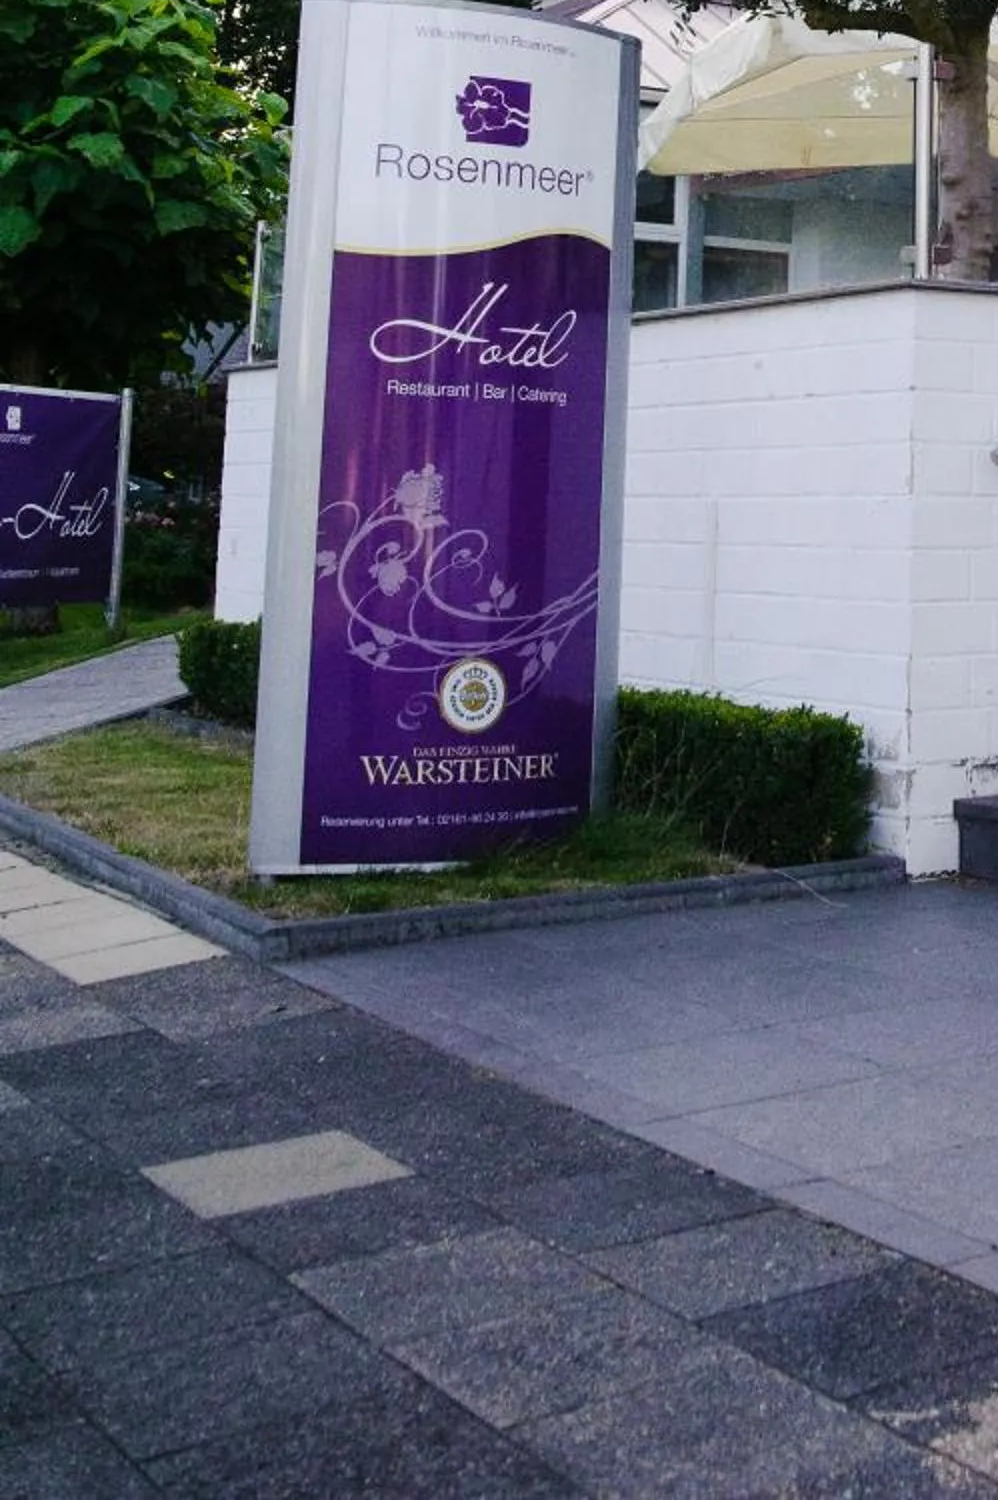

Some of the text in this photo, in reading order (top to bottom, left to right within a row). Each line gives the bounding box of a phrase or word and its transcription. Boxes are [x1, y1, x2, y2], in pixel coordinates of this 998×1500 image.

[370, 281, 577, 368] Hotel
[387, 379, 567, 407] Restaurant Bar Catering
[360, 754, 558, 786] WARSTEINER
